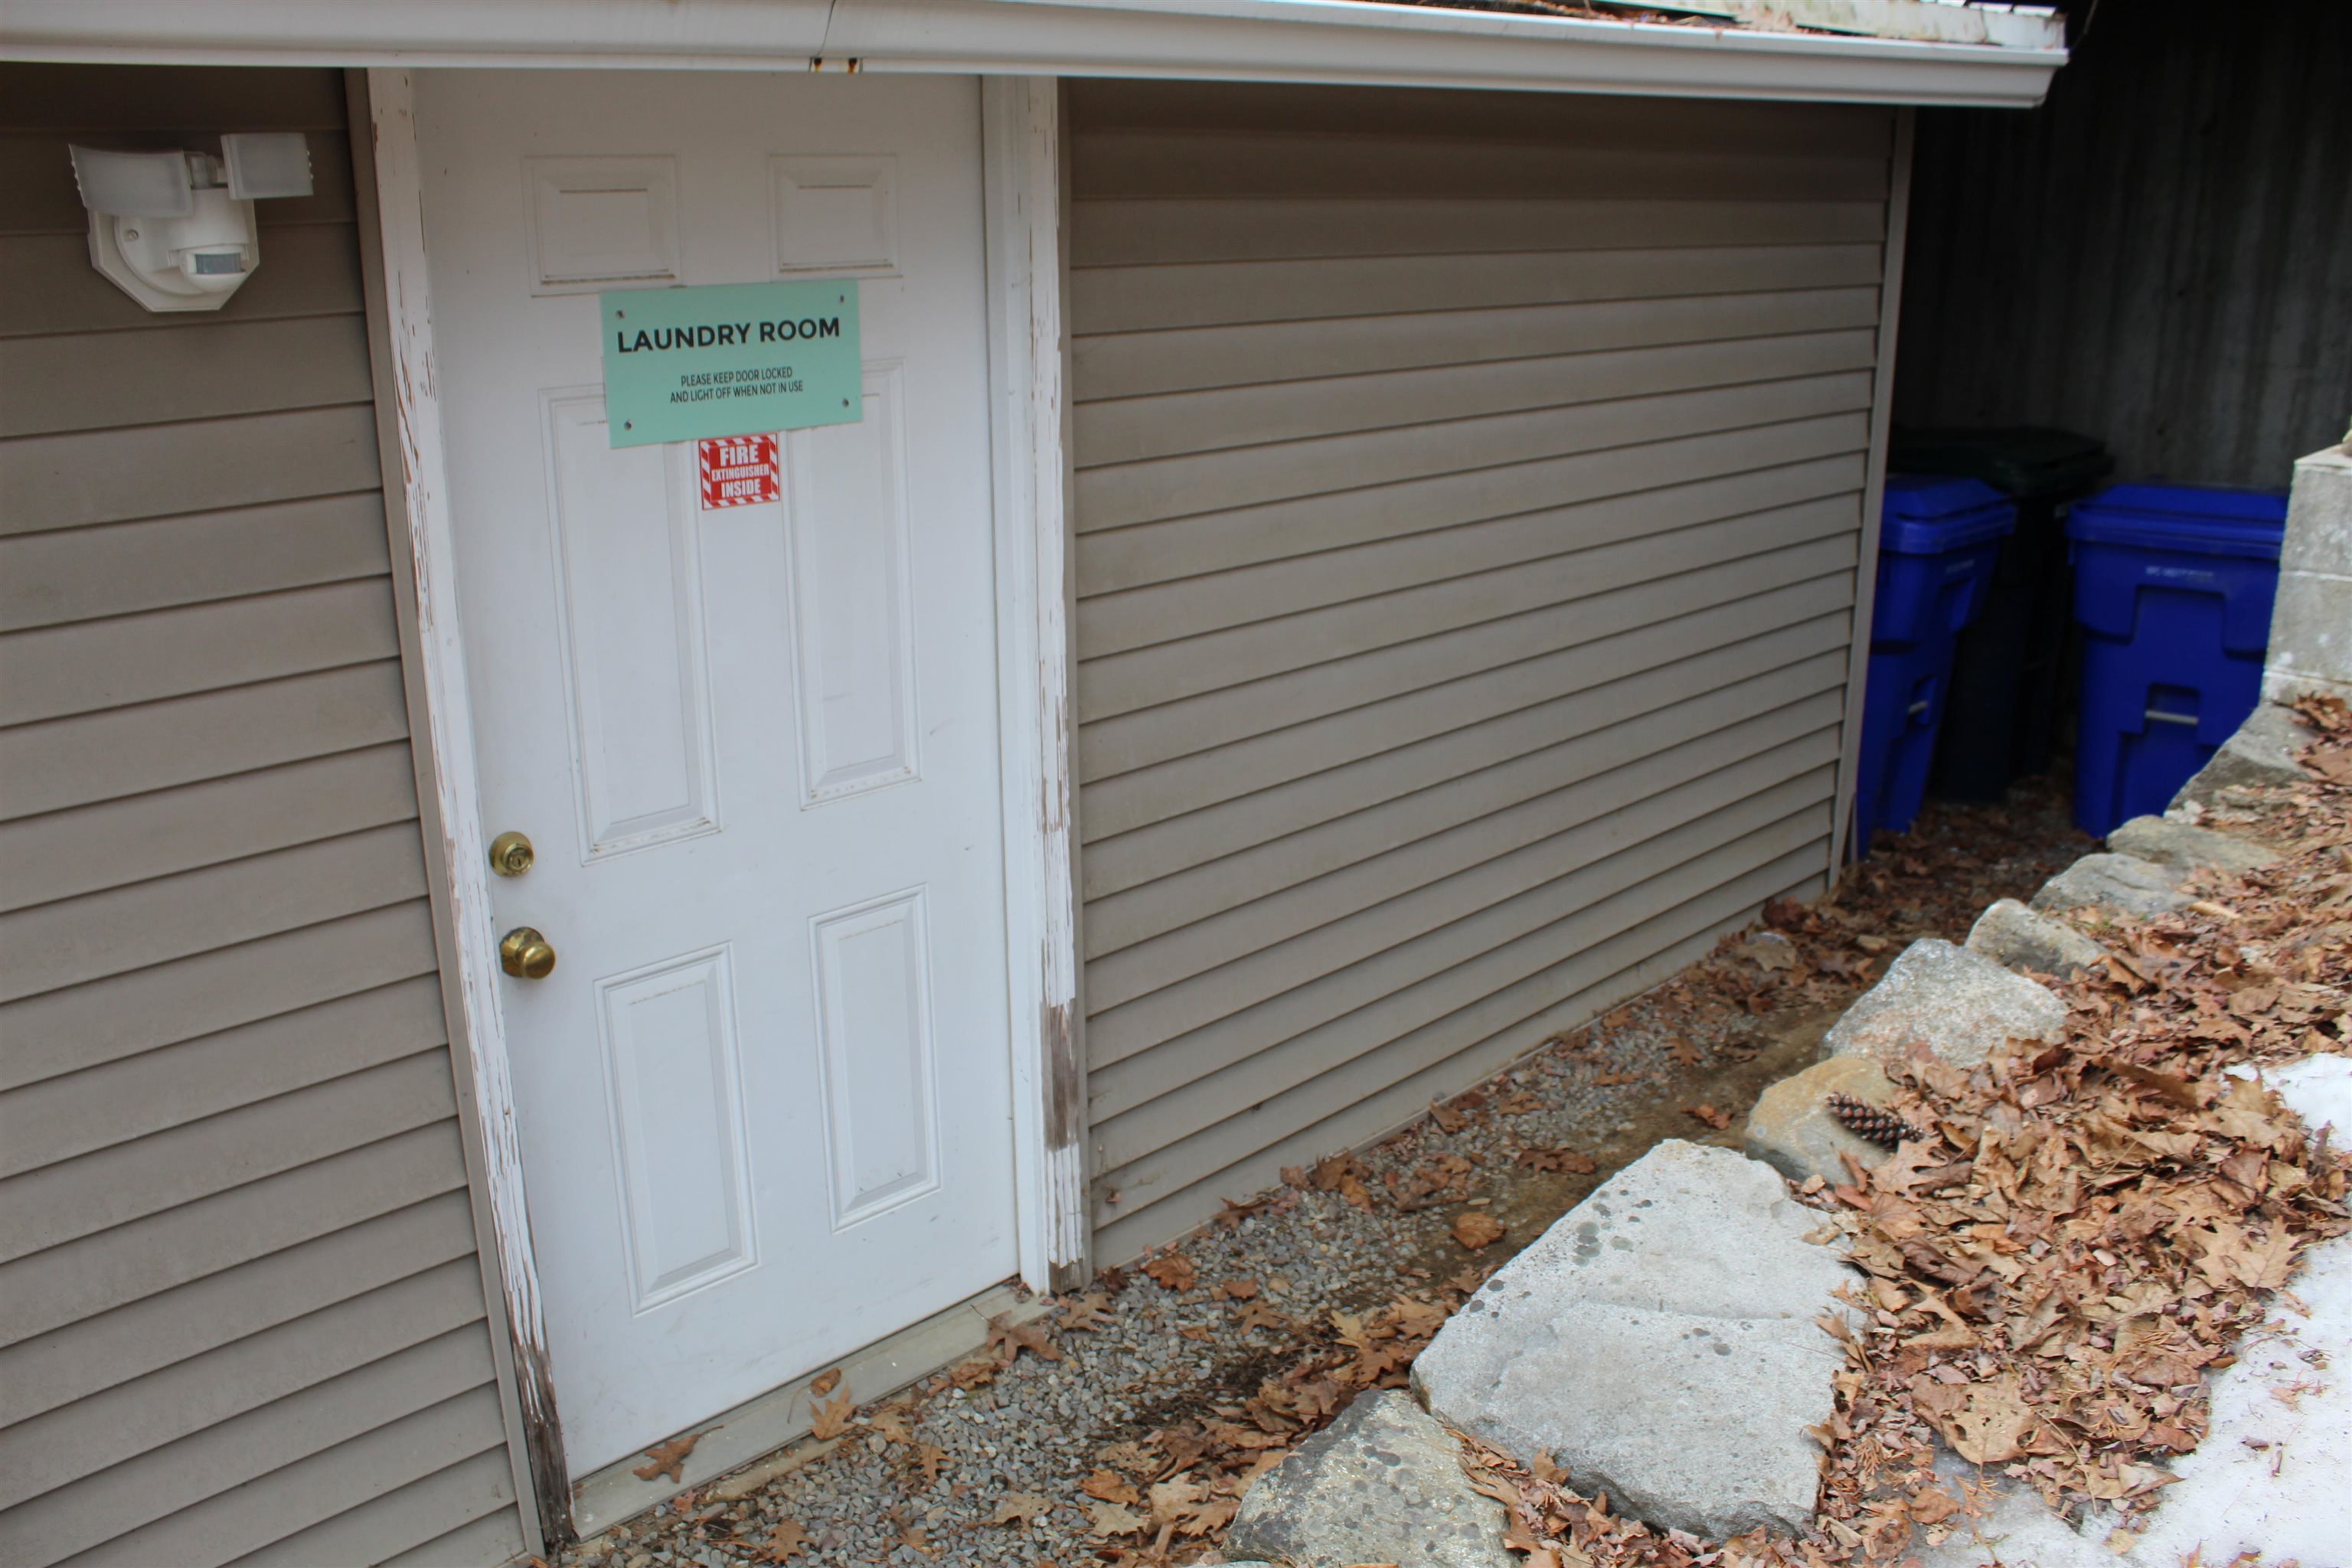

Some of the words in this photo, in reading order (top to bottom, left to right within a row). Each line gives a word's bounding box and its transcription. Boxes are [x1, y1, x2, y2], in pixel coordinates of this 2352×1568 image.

[617, 322, 751, 353] LAUNDRY
[759, 318, 840, 342] ROOM
[681, 373, 711, 386] PLEASE
[713, 371, 734, 384] KEEP
[736, 369, 760, 382] DOOR
[761, 366, 793, 380] LOCKED
[670, 390, 688, 403] AND
[691, 388, 714, 402] LIGHT
[715, 387, 731, 399] OFF
[733, 384, 758, 397] WHEN
[760, 383, 776, 395] NOT
[778, 381, 786, 393] IN
[788, 381, 803, 392] USE
[720, 444, 760, 466] FIRE
[711, 463, 769, 482] EXTINGUISHER
[720, 479, 761, 498] INSIDE
